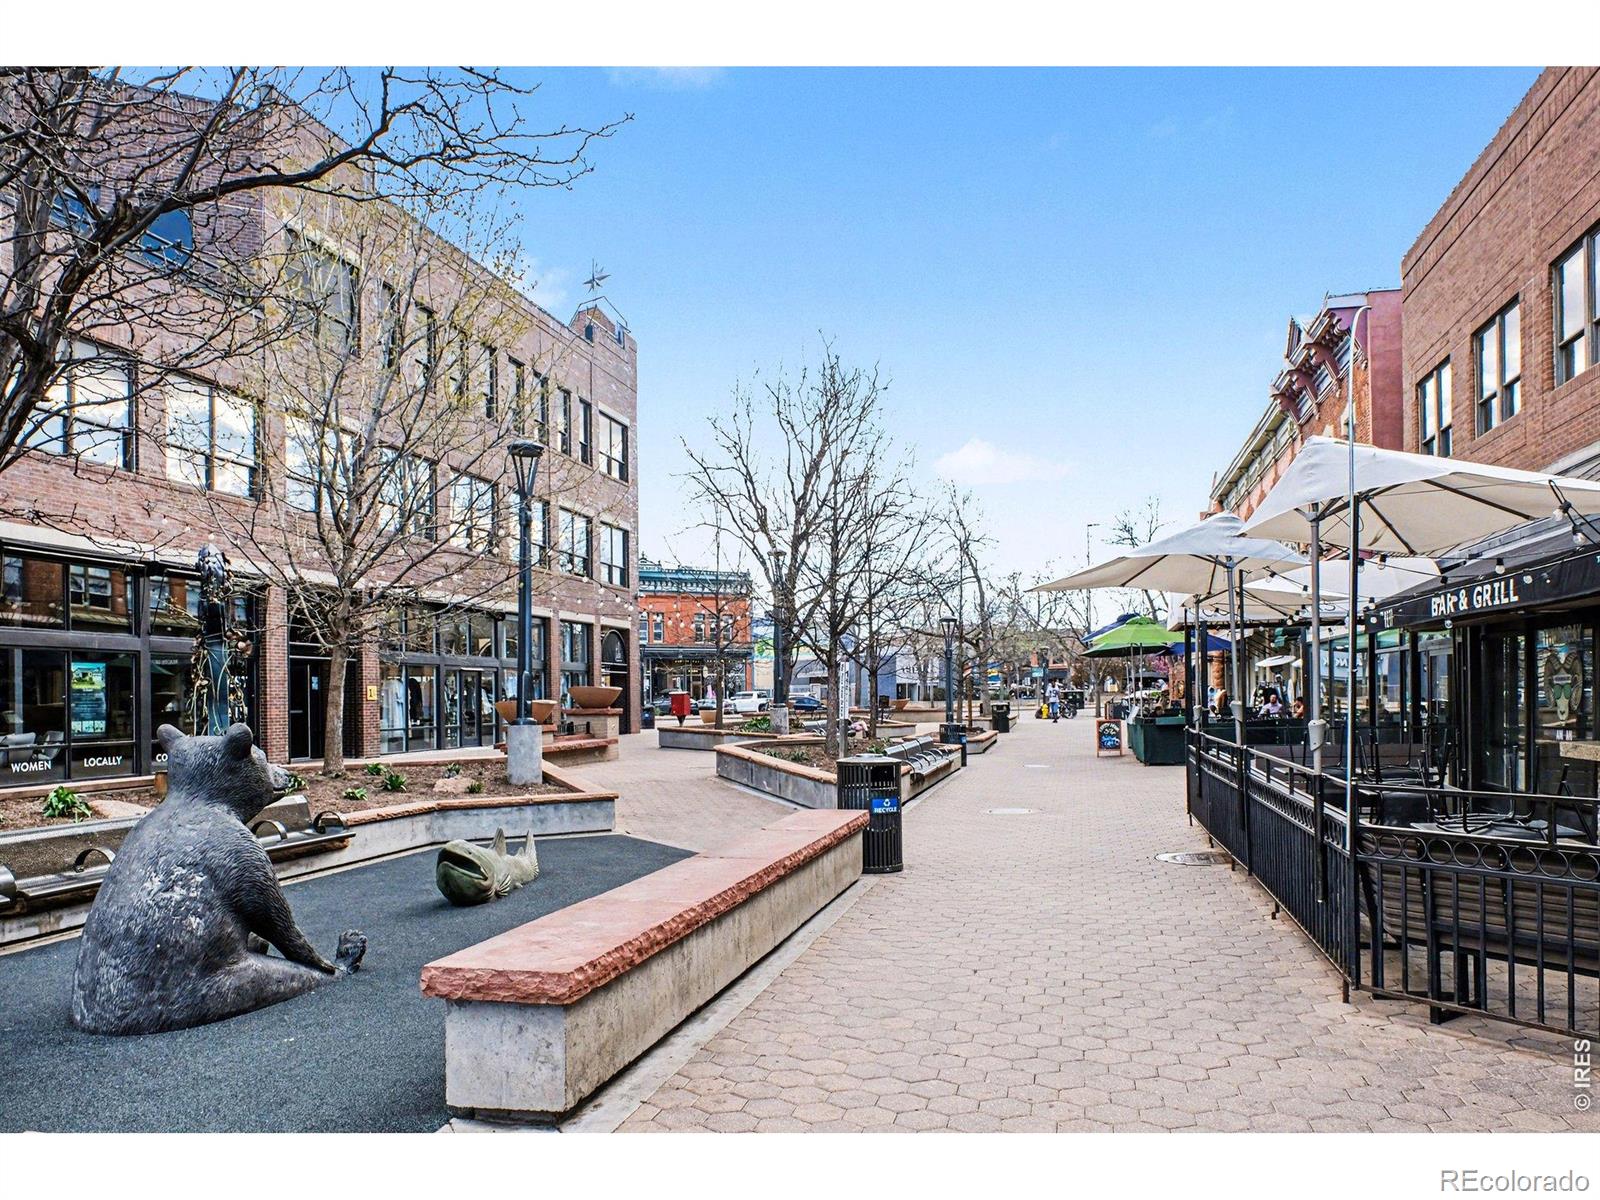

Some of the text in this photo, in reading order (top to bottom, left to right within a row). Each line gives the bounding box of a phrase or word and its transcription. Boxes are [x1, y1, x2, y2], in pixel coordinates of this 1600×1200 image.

[1431, 578, 1519, 617] BAR & GRILL
[11, 761, 52, 773] WOMEN
[83, 755, 123, 768] LOCALLY
[873, 806, 897, 814] RECYCLE
